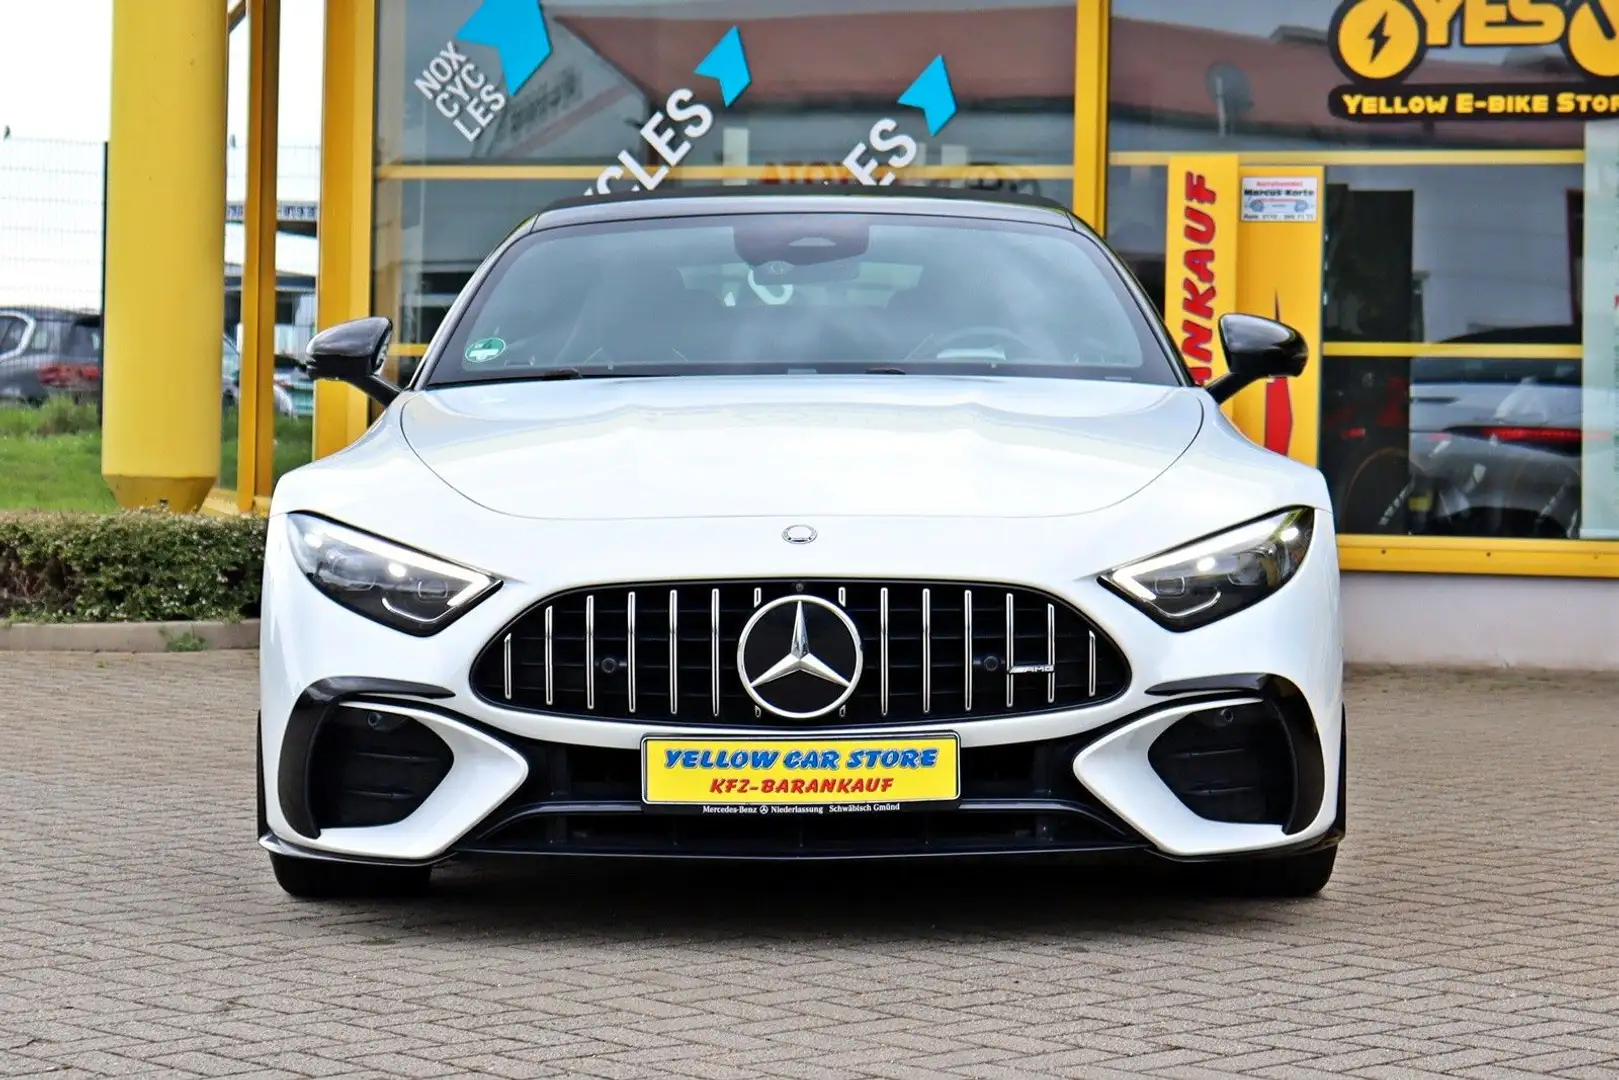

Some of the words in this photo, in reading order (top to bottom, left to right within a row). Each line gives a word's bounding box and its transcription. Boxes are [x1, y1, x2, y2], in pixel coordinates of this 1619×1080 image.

[1414, 0, 1566, 46] YES
[413, 40, 468, 100] NOX
[434, 63, 485, 119] CYC
[453, 84, 506, 142] LES
[842, 117, 918, 187] ES
[664, 749, 778, 769] YELLOW
[783, 749, 840, 770] CAR
[846, 748, 940, 769] STORE
[702, 805, 757, 814] Mercedes-Benz
[771, 805, 824, 814] Niederlassung
[829, 803, 872, 813] Schwäbisch
[873, 803, 900, 812] Gmünd
[709, 777, 893, 794] KFZ-BARANKAUF
